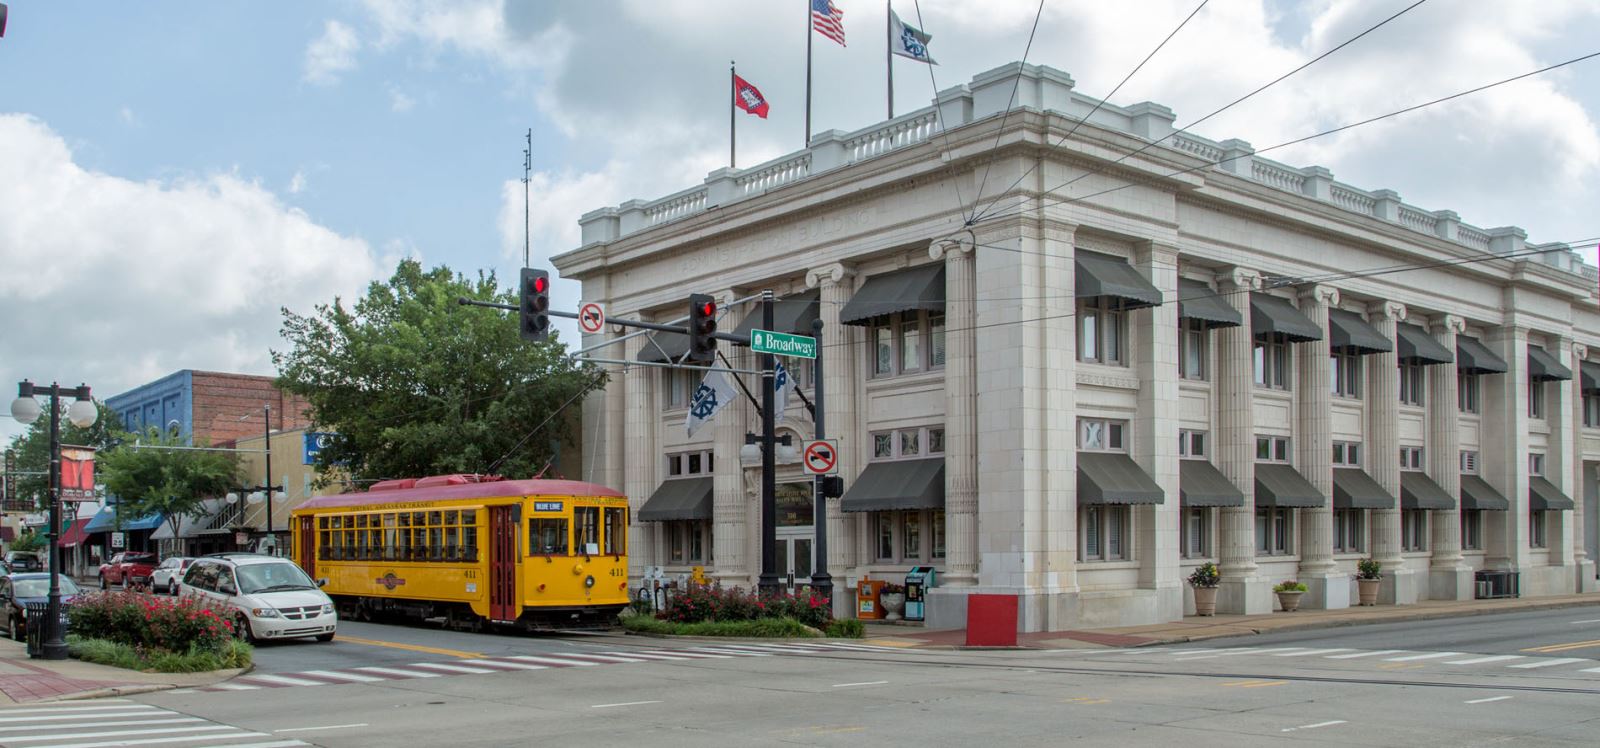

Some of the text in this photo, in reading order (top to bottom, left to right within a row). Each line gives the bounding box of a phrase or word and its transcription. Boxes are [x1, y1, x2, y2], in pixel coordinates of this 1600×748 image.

[801, 211, 870, 240] BUILDING
[766, 333, 813, 357] Broadway
[535, 502, 561, 511] BLUE LINE
[463, 570, 476, 579] 411
[608, 568, 624, 577] 411
